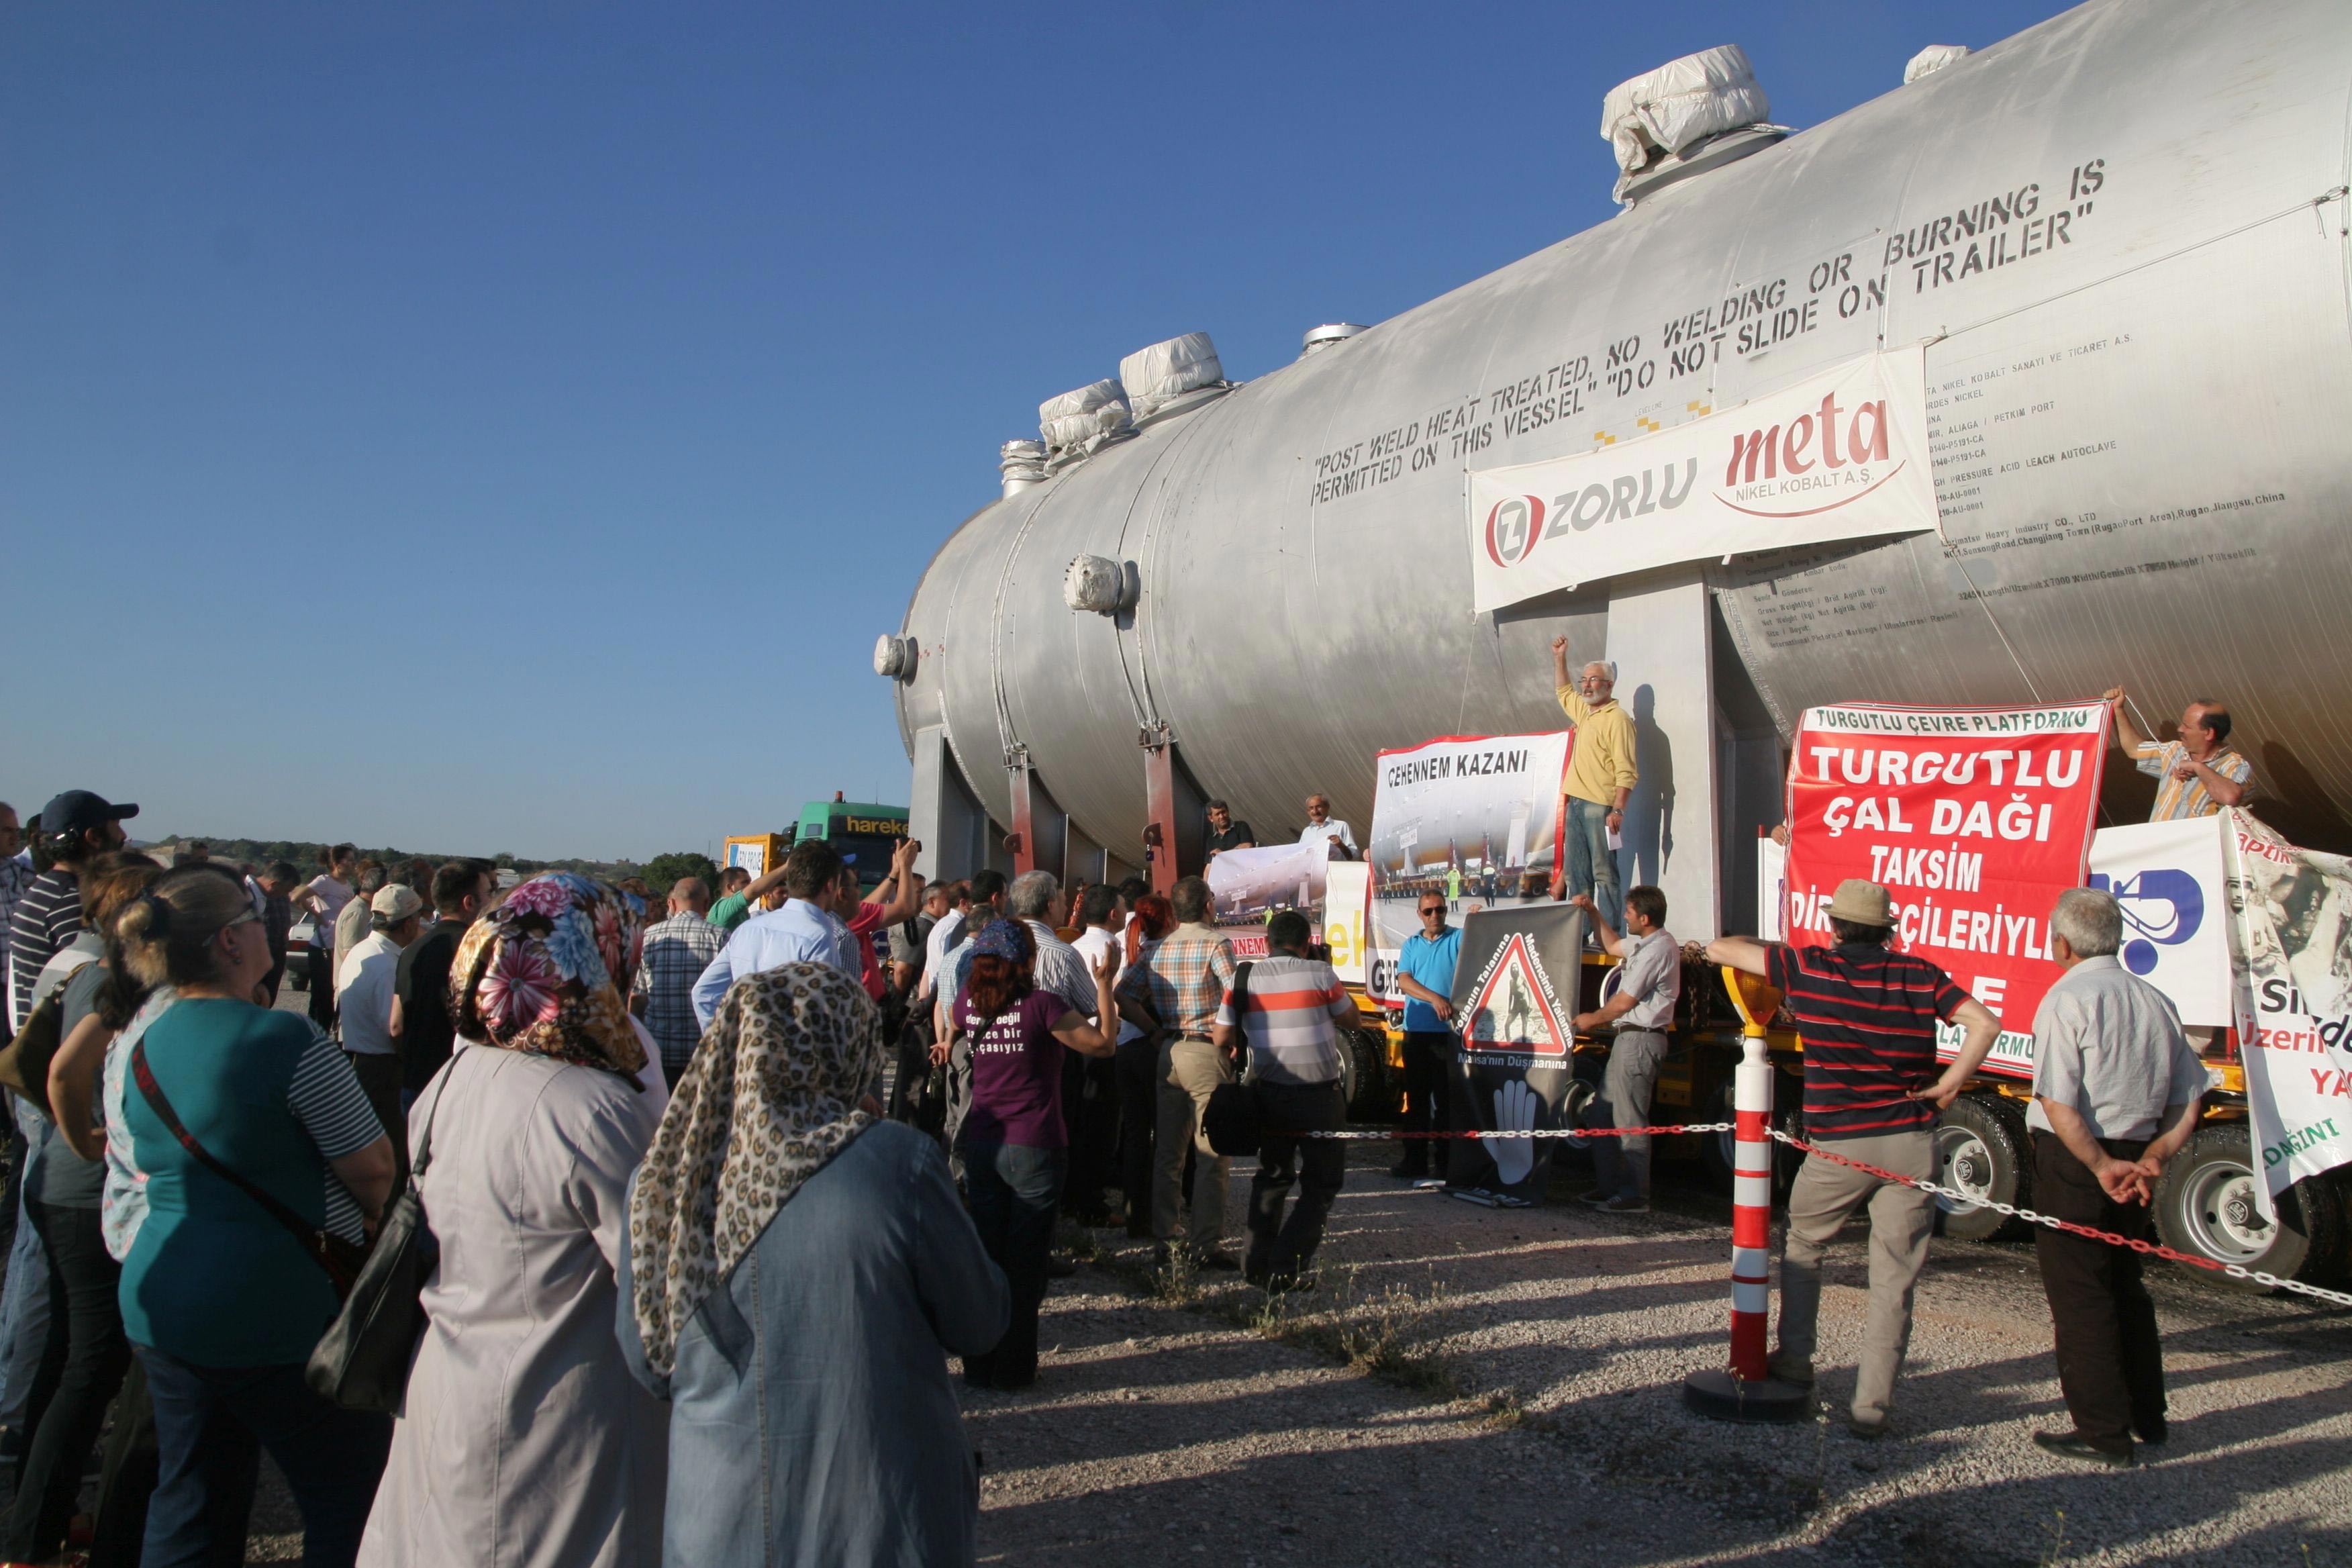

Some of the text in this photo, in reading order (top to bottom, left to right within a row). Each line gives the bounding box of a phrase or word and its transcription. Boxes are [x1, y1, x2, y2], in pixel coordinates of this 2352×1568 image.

[1369, 422, 1418, 460] WELD
[1426, 398, 1481, 440] HEAT
[1491, 356, 1592, 415] TREATED,
[1606, 335, 1640, 371] NO
[1664, 279, 1786, 349] WELDING
[1809, 253, 1853, 293] OR
[1883, 183, 2039, 267] BURNING
[2069, 158, 2105, 201] IS
[1311, 454, 1402, 507] PERMITTED
[1412, 441, 1438, 471] ON
[1451, 422, 1492, 459] THIS
[1504, 380, 1597, 440] VESSEL"
[1669, 333, 1726, 380] NOT
[1736, 299, 1819, 354] SLIDE
[1838, 274, 1888, 319] ON
[1912, 201, 2093, 294] TRAILER"
[1943, 379, 1965, 391] NIKEL
[1971, 367, 2006, 383] KOBALT
[2012, 357, 2045, 373] SANAYI
[2050, 352, 2062, 362] VE
[2068, 340, 2108, 358] TICARET
[1955, 389, 1983, 403] NICKEL
[1726, 390, 1890, 487] meta
[1948, 420, 1979, 435] ALIAGA
[1994, 407, 2026, 424] PETKIM
[2030, 401, 2055, 414] PORT
[1951, 467, 1993, 484] PRESSURE
[2000, 461, 2020, 474] ACID
[2026, 454, 2055, 468] LEACH
[2061, 440, 2116, 460] AUTOCLAVE
[1544, 457, 1698, 541] ZORLU
[1736, 468, 1875, 502] NİKEL KOBALT A.Ş.
[2255, 493, 2285, 504] China
[2015, 520, 2049, 534] Industry
[2079, 512, 2096, 524] LTD
[1816, 708, 2088, 735] TURGUTLU ÇEVRE PLATFORMU
[1388, 749, 1528, 788] CEHENNEM KAZANI
[1810, 746, 2084, 788] TURGUTLU
[1822, 793, 2053, 842] ÇAL DAĞI
[1870, 842, 1983, 893] TAKSİM
[1477, 933, 1510, 984] Talanına
[1524, 932, 1573, 1048] Madencinin Yalanına
[1003, 1028, 1021, 1038] bir
[1508, 1055, 1567, 1070] Düşmanına
